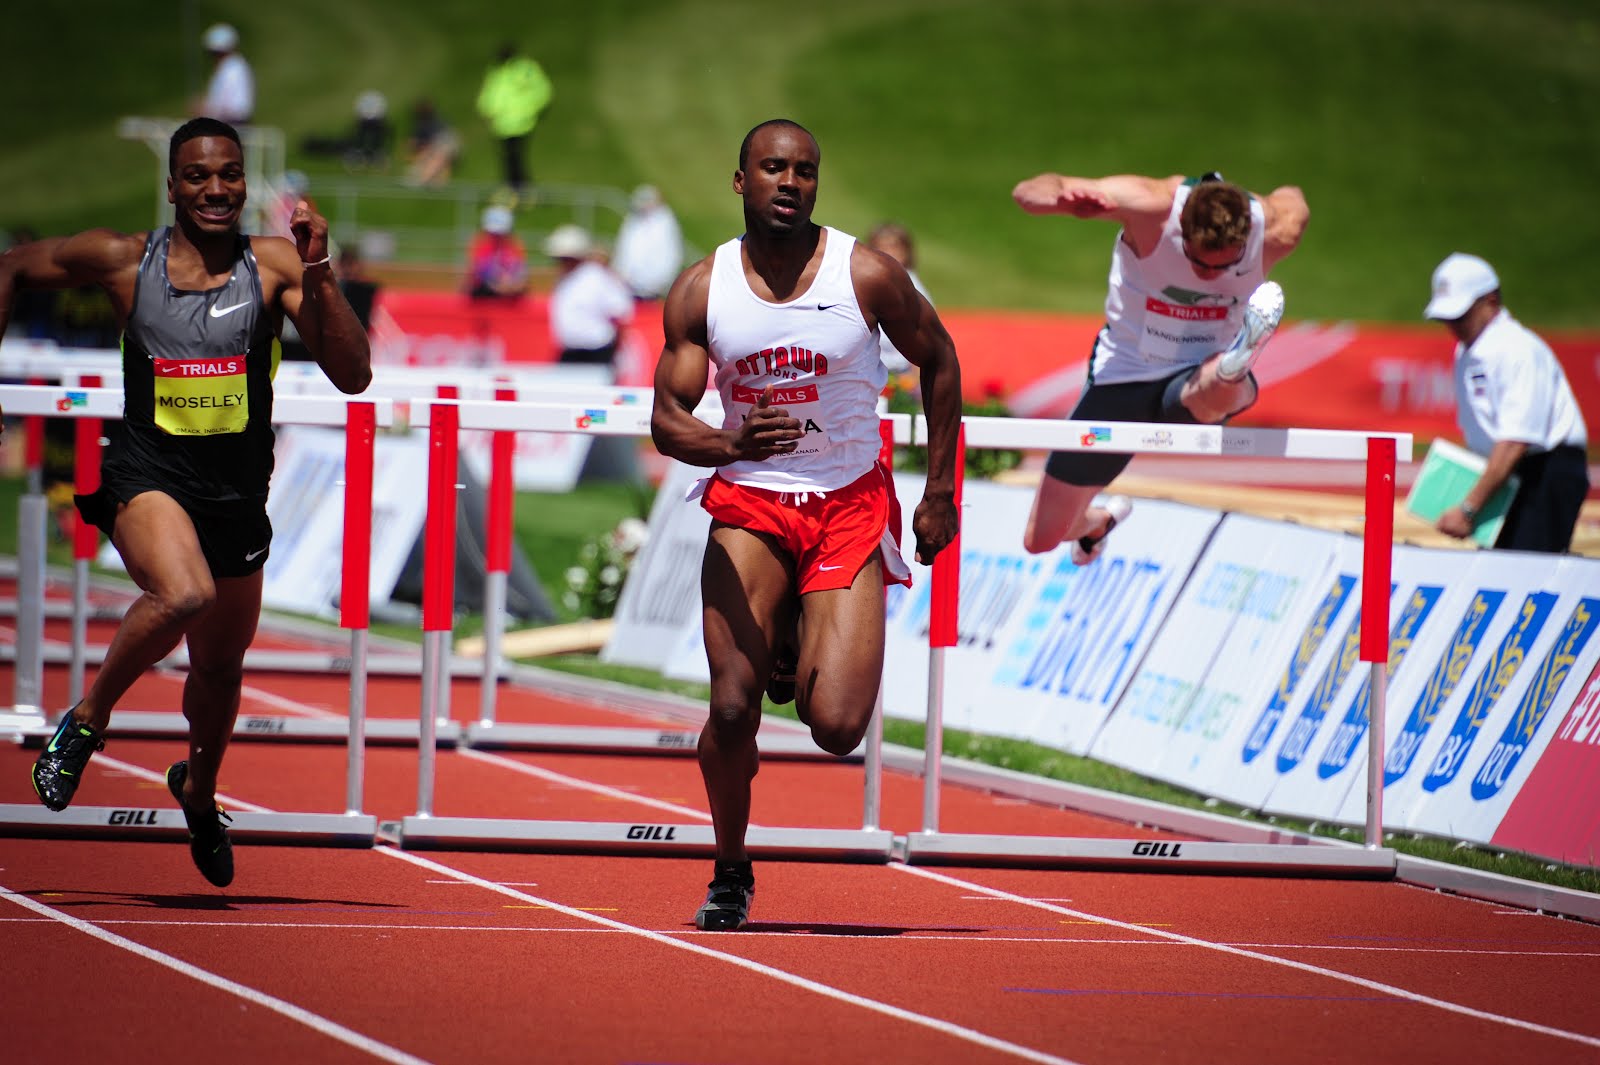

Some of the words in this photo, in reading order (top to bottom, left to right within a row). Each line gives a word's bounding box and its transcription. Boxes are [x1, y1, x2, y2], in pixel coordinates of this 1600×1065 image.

[1167, 306, 1218, 319] TRIALS
[179, 361, 237, 376] TRIALS
[735, 346, 828, 376] OTTAWA
[159, 393, 244, 409] MOSELEY
[108, 810, 158, 825] GILL
[626, 825, 676, 840] GILL
[1132, 842, 1182, 857] GILL
